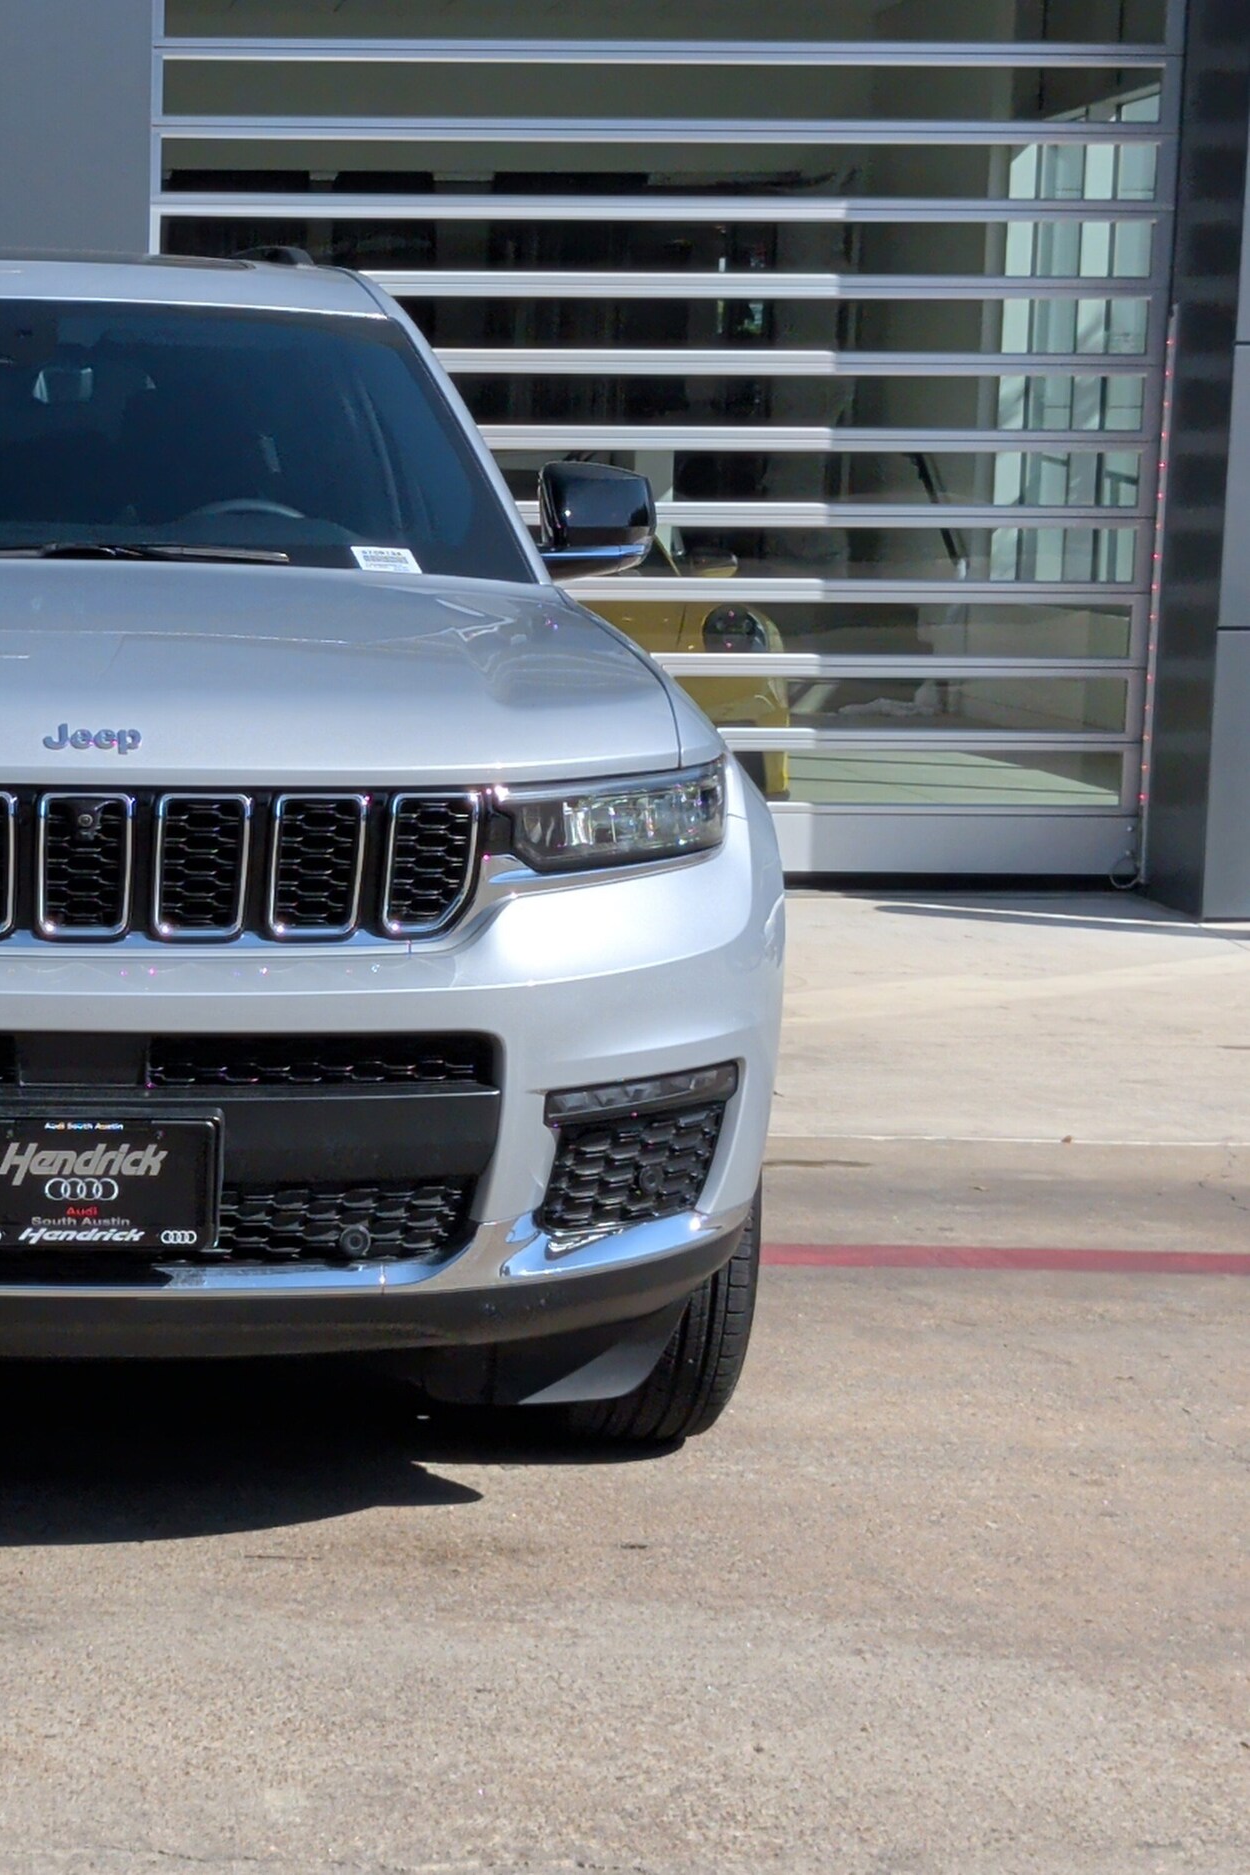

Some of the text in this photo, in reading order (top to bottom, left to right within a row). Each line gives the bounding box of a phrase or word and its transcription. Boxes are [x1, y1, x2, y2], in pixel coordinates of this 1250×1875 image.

[42, 723, 141, 755] Jeep
[44, 1122, 124, 1131] Audi South Austin
[66, 1206, 98, 1216] Audi
[31, 1216, 130, 1226] South Austin
[18, 1228, 145, 1244] Hendrick
